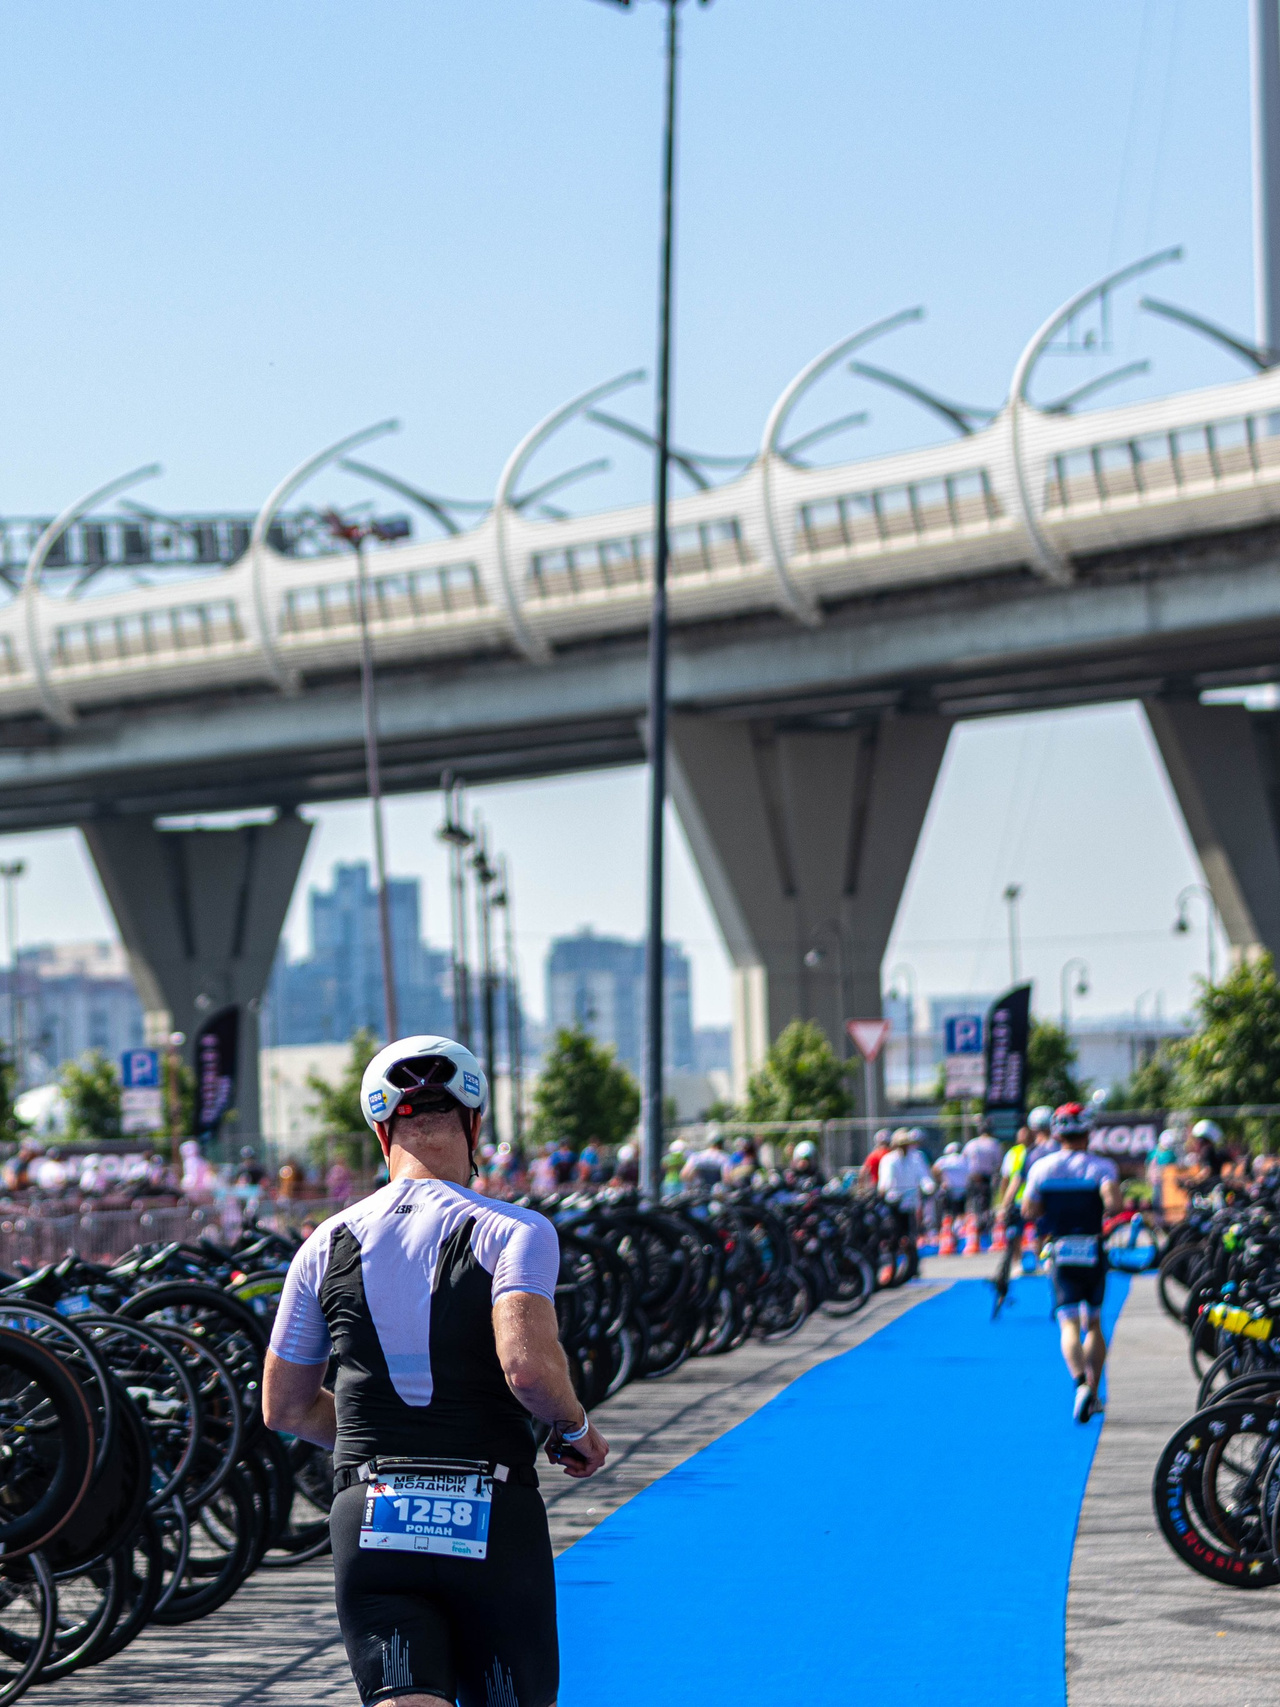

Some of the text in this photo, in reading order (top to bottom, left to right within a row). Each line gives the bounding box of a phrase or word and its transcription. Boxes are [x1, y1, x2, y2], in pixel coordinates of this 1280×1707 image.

[955, 1019, 978, 1052] P
[130, 1053, 153, 1085] P
[393, 1481, 466, 1494] ВСАДНИК
[393, 1497, 473, 1527] 1258
[405, 1524, 453, 1537] РОМАН
[451, 1545, 472, 1555] fresh
